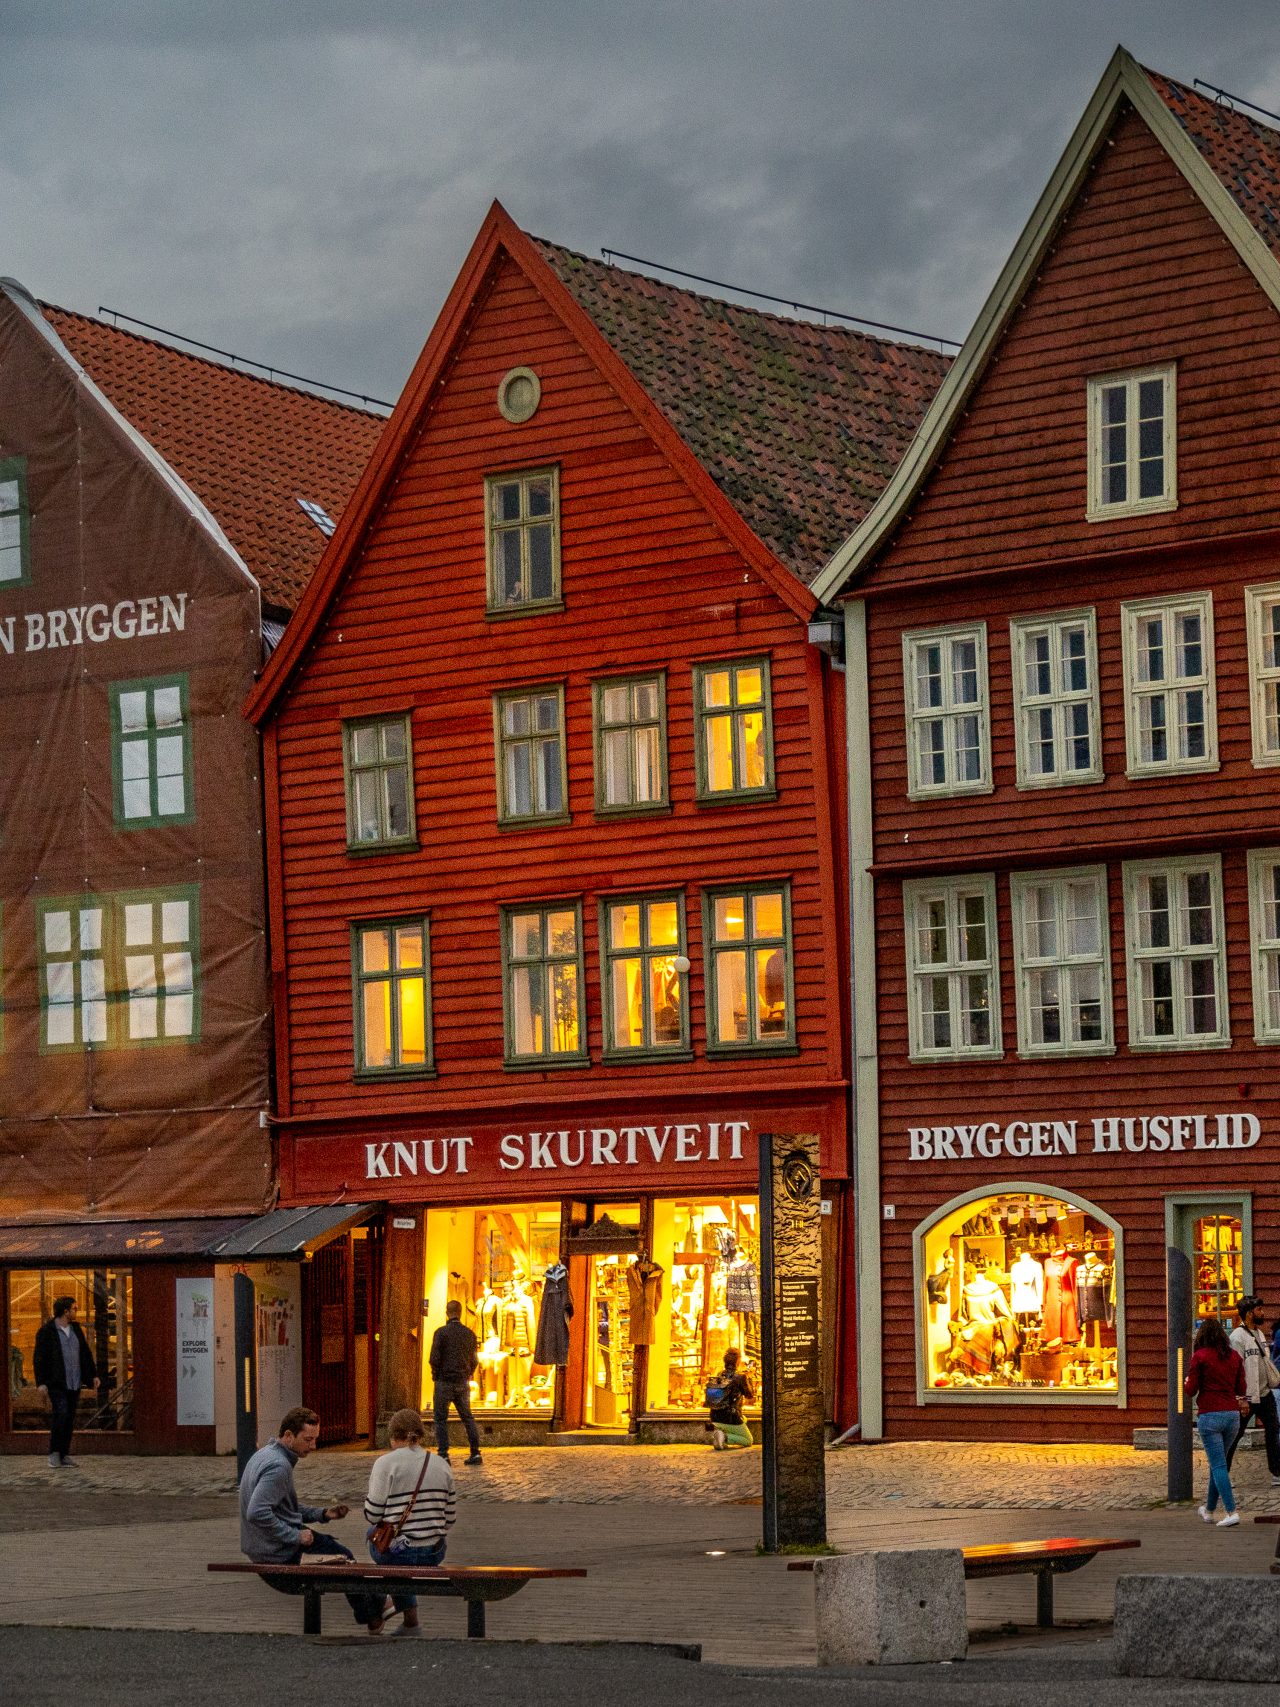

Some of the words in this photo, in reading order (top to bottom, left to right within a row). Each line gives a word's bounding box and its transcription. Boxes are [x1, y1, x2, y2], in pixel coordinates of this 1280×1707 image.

[25, 593, 188, 652] BRYGGEN
[365, 1137, 474, 1179] KNUT
[500, 1121, 750, 1170] SKURTVEIT
[908, 1120, 1079, 1161] BRYGGEN
[1091, 1113, 1262, 1153] HUSFLID
